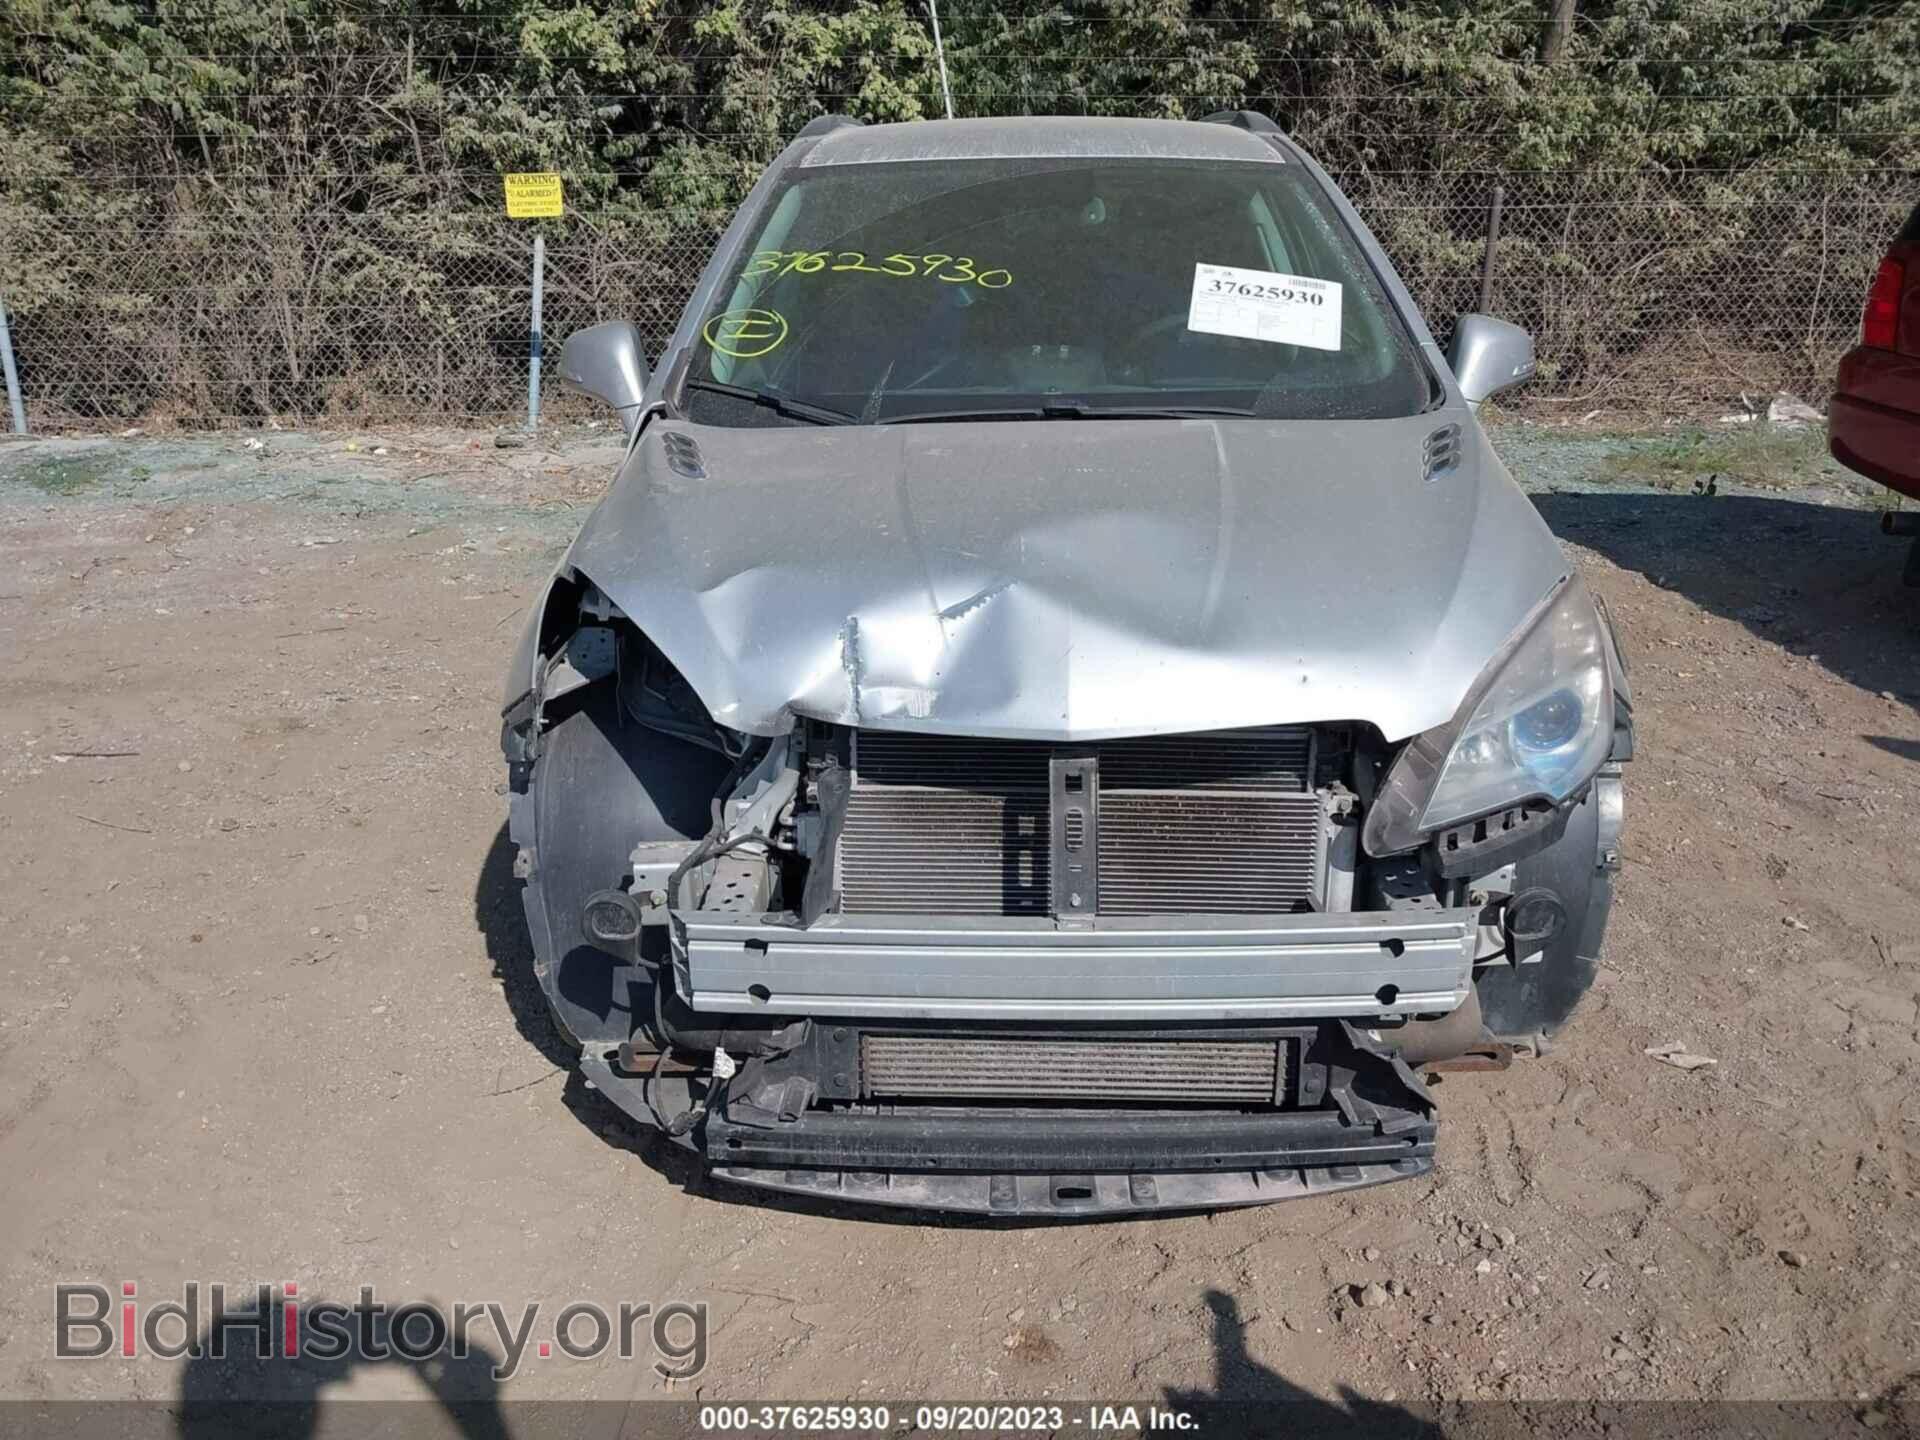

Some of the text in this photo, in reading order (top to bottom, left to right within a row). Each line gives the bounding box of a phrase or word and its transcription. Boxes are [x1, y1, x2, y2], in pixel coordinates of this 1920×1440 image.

[507, 175, 556, 185] WARNING
[740, 250, 1014, 289] 37625930
[1207, 279, 1324, 307] 37625930
